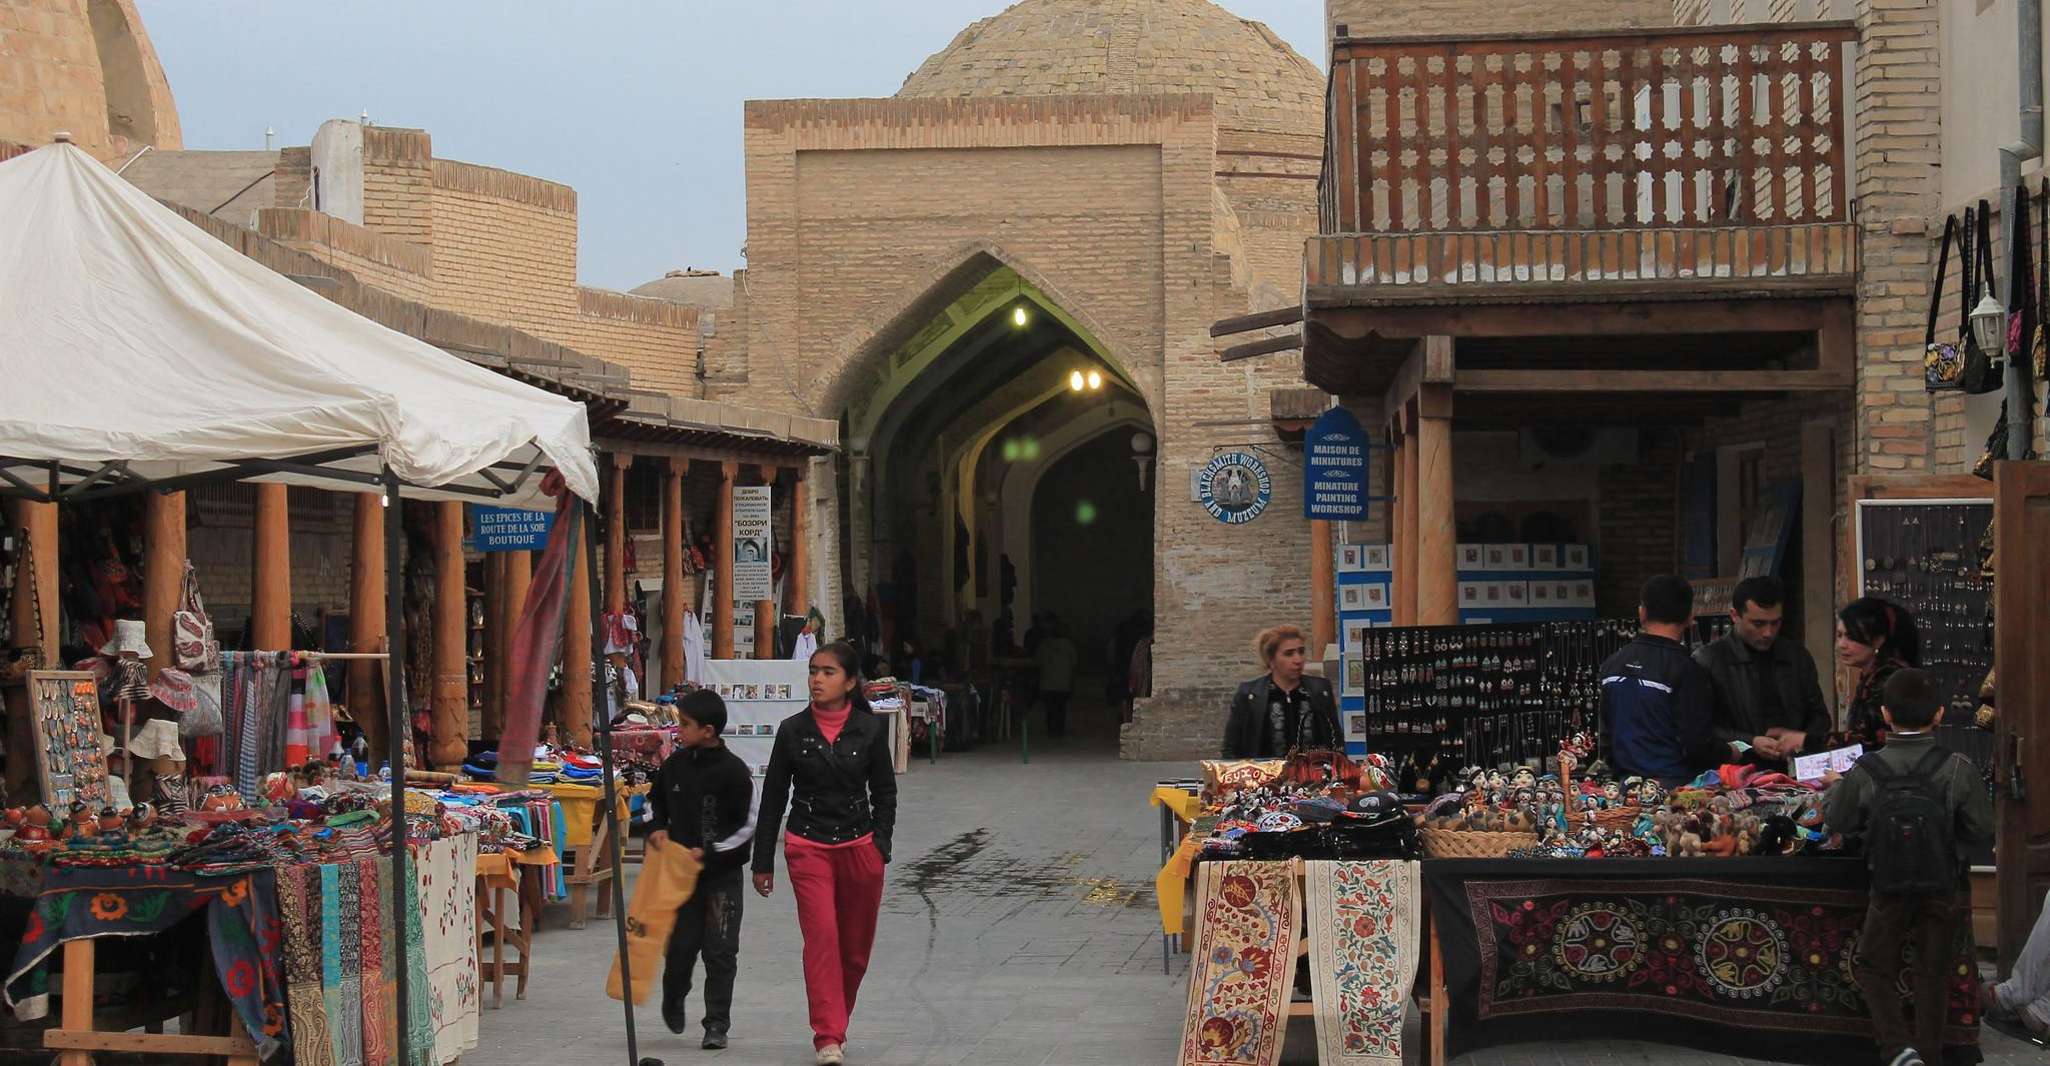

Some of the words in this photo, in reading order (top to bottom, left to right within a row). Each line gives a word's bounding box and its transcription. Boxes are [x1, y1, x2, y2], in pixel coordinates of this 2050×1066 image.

[1314, 445, 1347, 455] MAISON
[1349, 446, 1360, 455] DE
[1311, 457, 1362, 466] MINIATURES
[1201, 453, 1238, 498] BLACKSMITH
[1240, 454, 1270, 494] WORKSHOP
[1314, 481, 1360, 491] MINATURE
[1316, 493, 1357, 503] PAINTING
[1205, 500, 1223, 517] AND
[1227, 497, 1267, 523] MUZEUM
[1311, 504, 1362, 514] WORKSHOP
[480, 513, 495, 523] LES
[496, 513, 521, 523] EPICES
[523, 512, 533, 522] DE
[535, 512, 545, 522] LA
[481, 524, 505, 535] ROUTE
[507, 524, 518, 534] DE
[519, 524, 528, 533] LA
[530, 523, 546, 533] SOIE
[489, 534, 535, 545] BOUTIQUE
